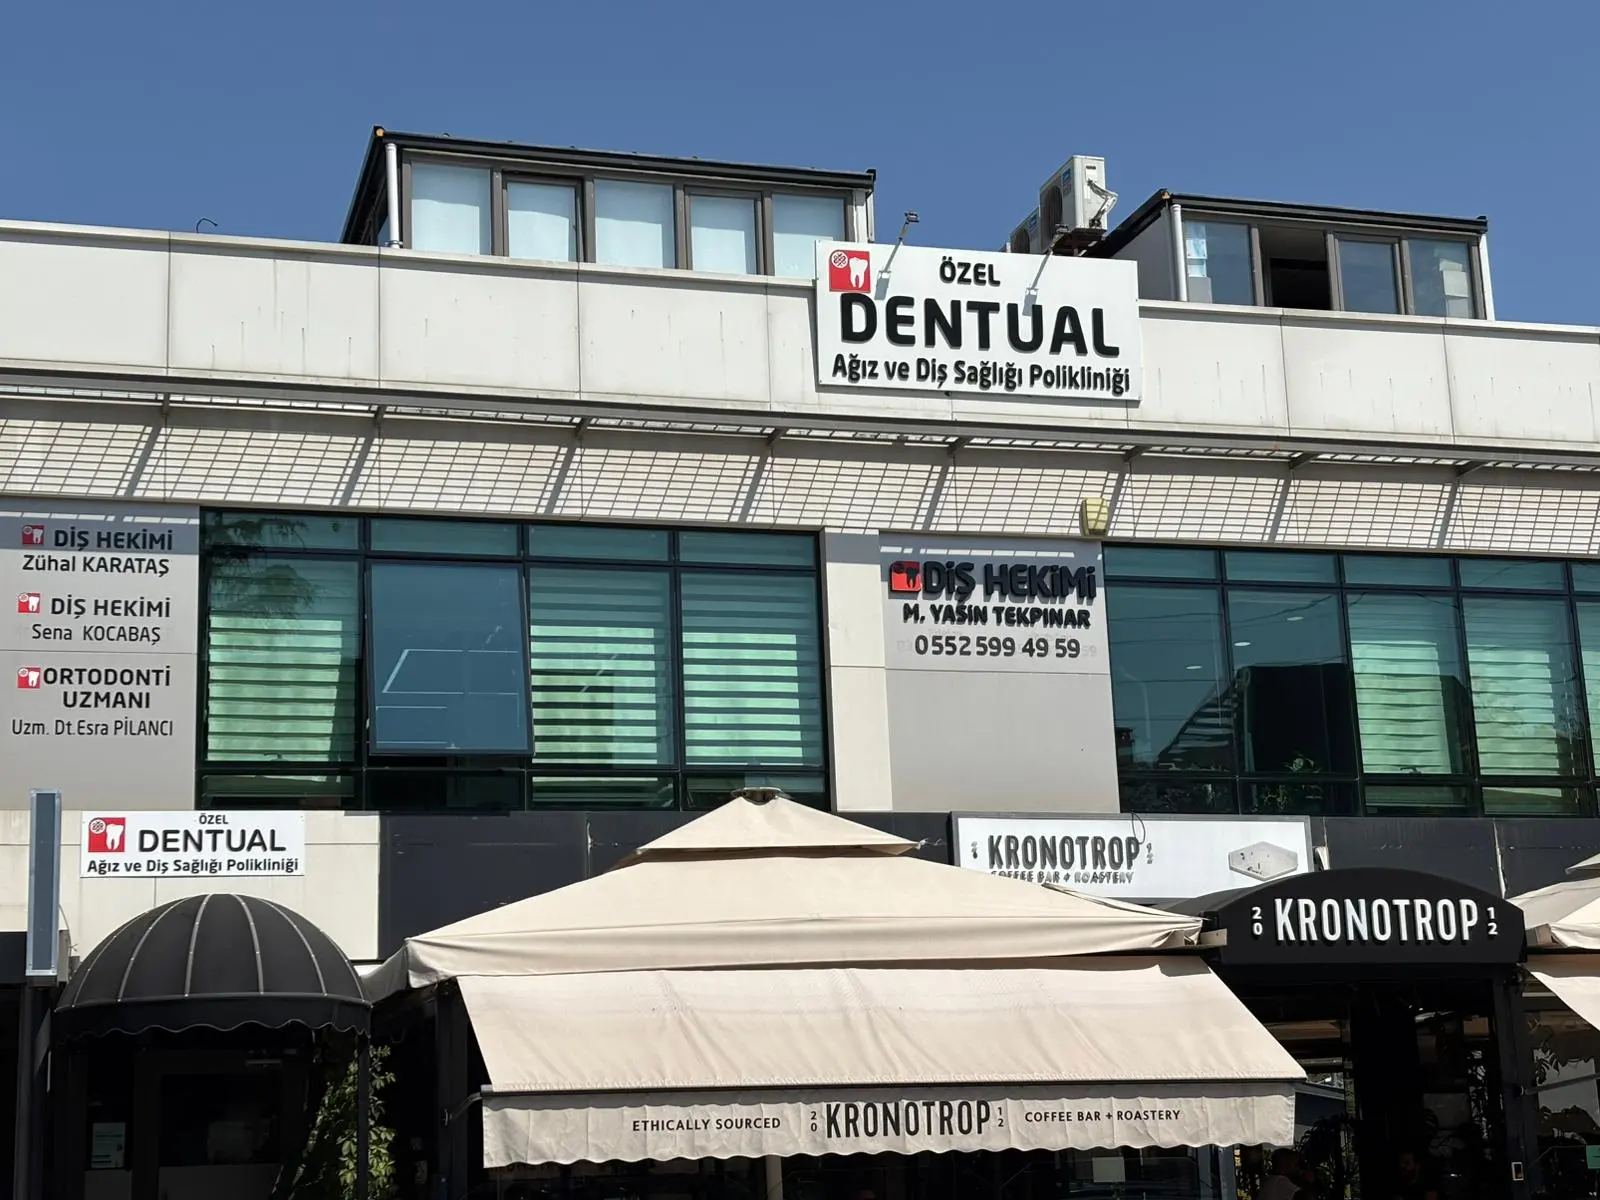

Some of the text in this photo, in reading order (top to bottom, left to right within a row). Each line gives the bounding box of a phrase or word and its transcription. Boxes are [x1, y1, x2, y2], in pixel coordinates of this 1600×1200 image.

[939, 256, 1001, 286] ÖZEL
[840, 292, 1120, 358] DENTUAL
[832, 353, 1130, 397] Ağız ve Diş Sağlığı Polikliniği
[54, 526, 173, 551] DİŞ HEKİMİ
[22, 554, 169, 577] Zühal KARATAŞ
[923, 561, 1097, 604] DİŞ HEKİMİ
[51, 594, 170, 619] DİŞ HEKİMİ
[992, 606, 1091, 629] TEKPINAR
[32, 623, 161, 646] Sena KOCABAŞ
[976, 636, 1016, 657] 599
[1022, 637, 1049, 658] 49
[1055, 638, 1081, 658] 59
[43, 665, 170, 686] ORTODONTİ
[63, 691, 150, 709] UZMANI
[12, 719, 50, 736] Uzm.
[113, 716, 173, 736] PİLANCI
[199, 813, 229, 825] ÖZEL
[138, 828, 287, 853] DENTUAL
[987, 835, 1140, 871] KRONOTROP
[87, 858, 299, 875] Ağız ve Diş Sağlığı Polikliniği
[1037, 871, 1060, 884] BAR
[1274, 898, 1479, 942] KRONOTROP
[632, 1118, 711, 1132] ETHICALLY
[716, 1117, 781, 1131] SOURCED
[826, 1100, 991, 1138] KRONOTROP
[1025, 1111, 1073, 1123] COFFEE
[1077, 1111, 1101, 1122] BAR
[1117, 1110, 1181, 1122] ROASTERY
